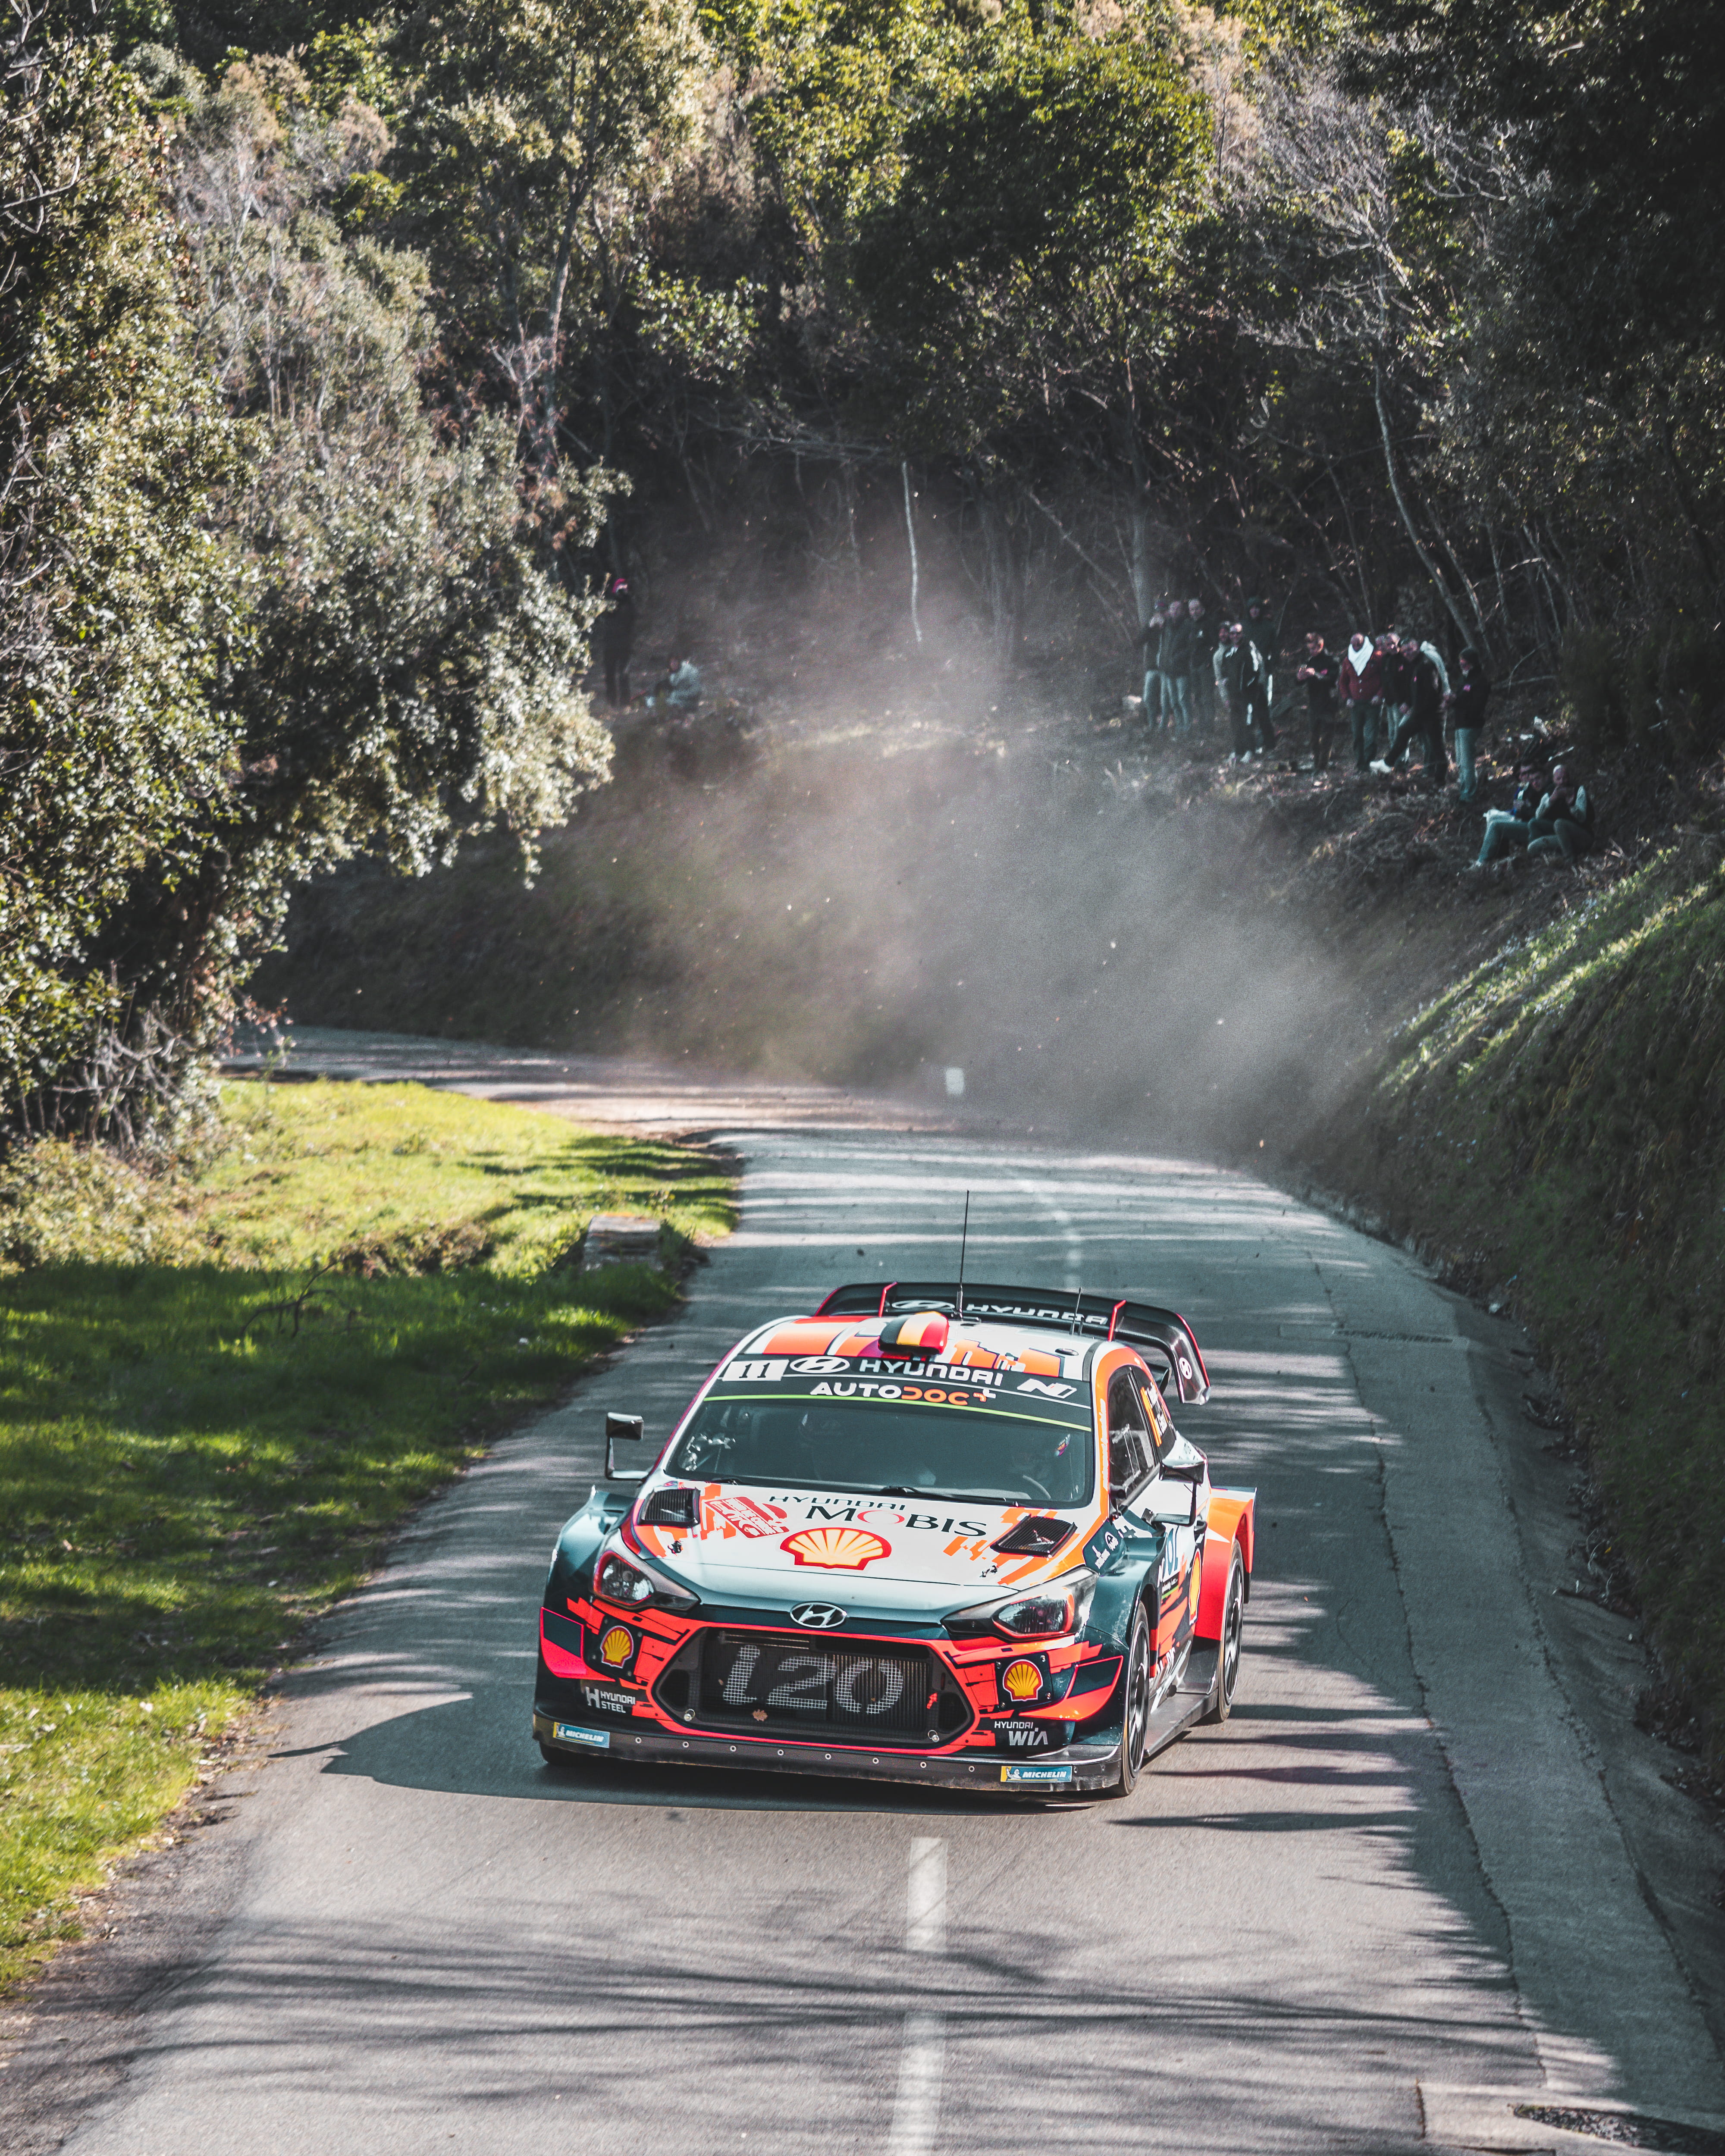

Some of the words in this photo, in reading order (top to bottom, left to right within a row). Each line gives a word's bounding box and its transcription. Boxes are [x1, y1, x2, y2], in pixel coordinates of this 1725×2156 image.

[966, 1304, 1108, 1325] HYUNDA
[738, 1362, 771, 1379] 11
[859, 1359, 1004, 1386] HYUNDAI
[809, 1382, 970, 1406] AUTODOC
[769, 1496, 906, 1510] HYUNDAI
[805, 1505, 987, 1536] MOBIS
[600, 1690, 636, 1705] HYUNDAI
[601, 1701, 626, 1713] STEEL
[994, 1721, 1034, 1729] HYUNDAI
[565, 1730, 604, 1742] MICHELIN
